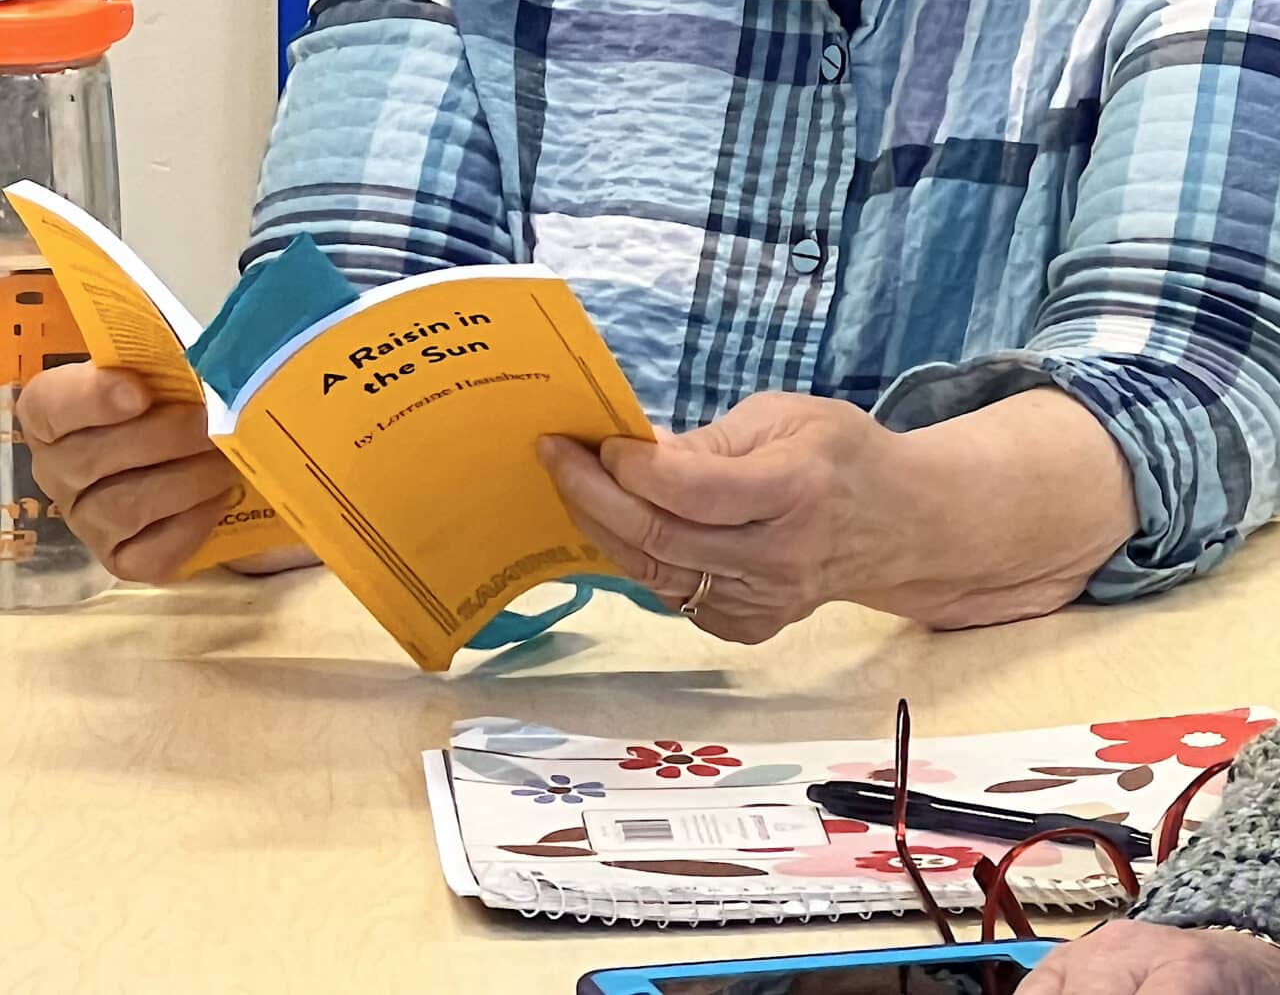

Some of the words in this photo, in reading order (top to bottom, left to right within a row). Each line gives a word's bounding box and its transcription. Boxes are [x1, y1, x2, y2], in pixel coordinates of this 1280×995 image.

[323, 373, 348, 395] A
[349, 322, 450, 369] Raisin
[454, 312, 491, 327] in
[363, 362, 415, 394] the
[421, 340, 489, 363] Sun
[354, 432, 373, 449] by
[376, 388, 453, 431] Lorraine
[455, 372, 551, 390] Hansberry
